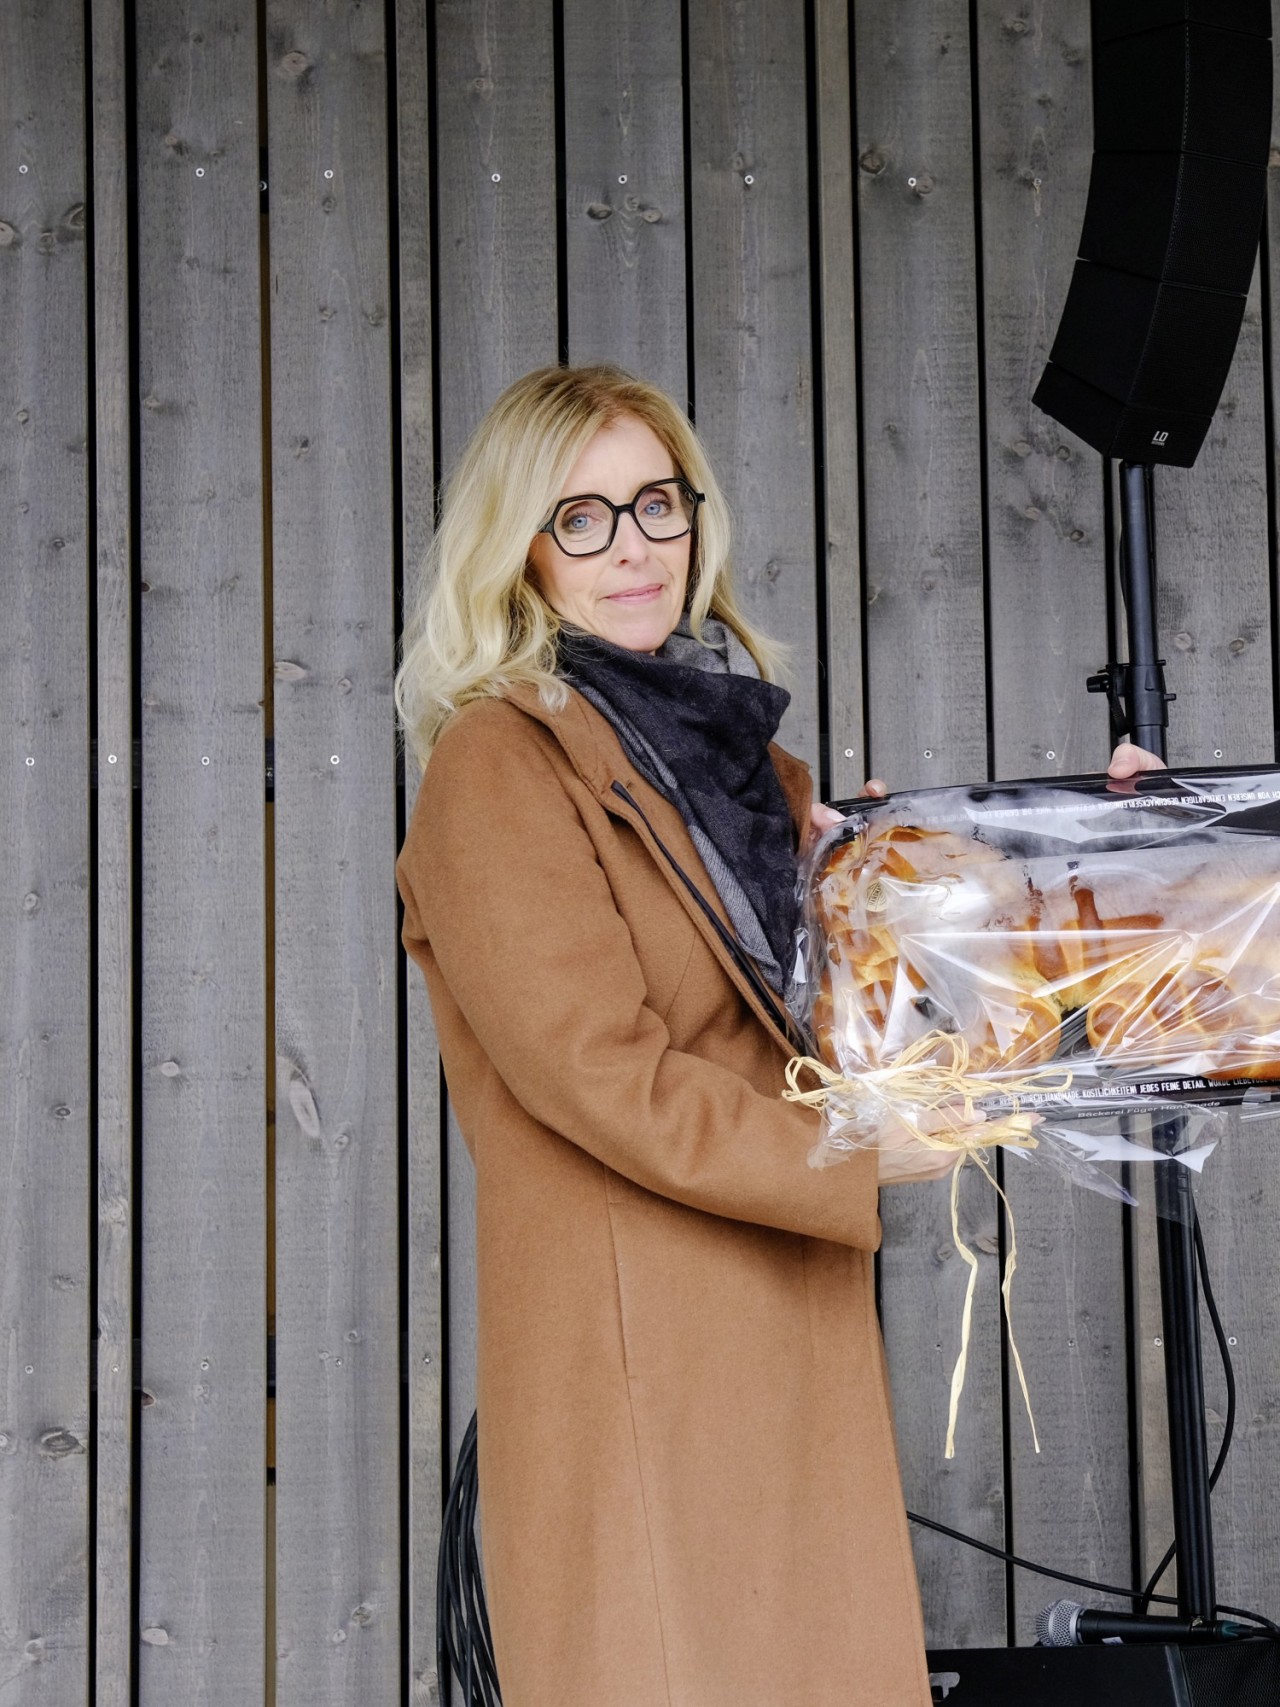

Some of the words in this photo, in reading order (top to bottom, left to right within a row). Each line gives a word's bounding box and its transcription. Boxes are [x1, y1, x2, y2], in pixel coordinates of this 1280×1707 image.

[1227, 792, 1256, 802] UNSEREN
[1257, 791, 1270, 800] VON
[1139, 1082, 1160, 1094] JEDES
[1161, 1080, 1181, 1091] FEINE
[1183, 1079, 1206, 1090] DETAIL
[1077, 1108, 1124, 1118] Bäckerei
